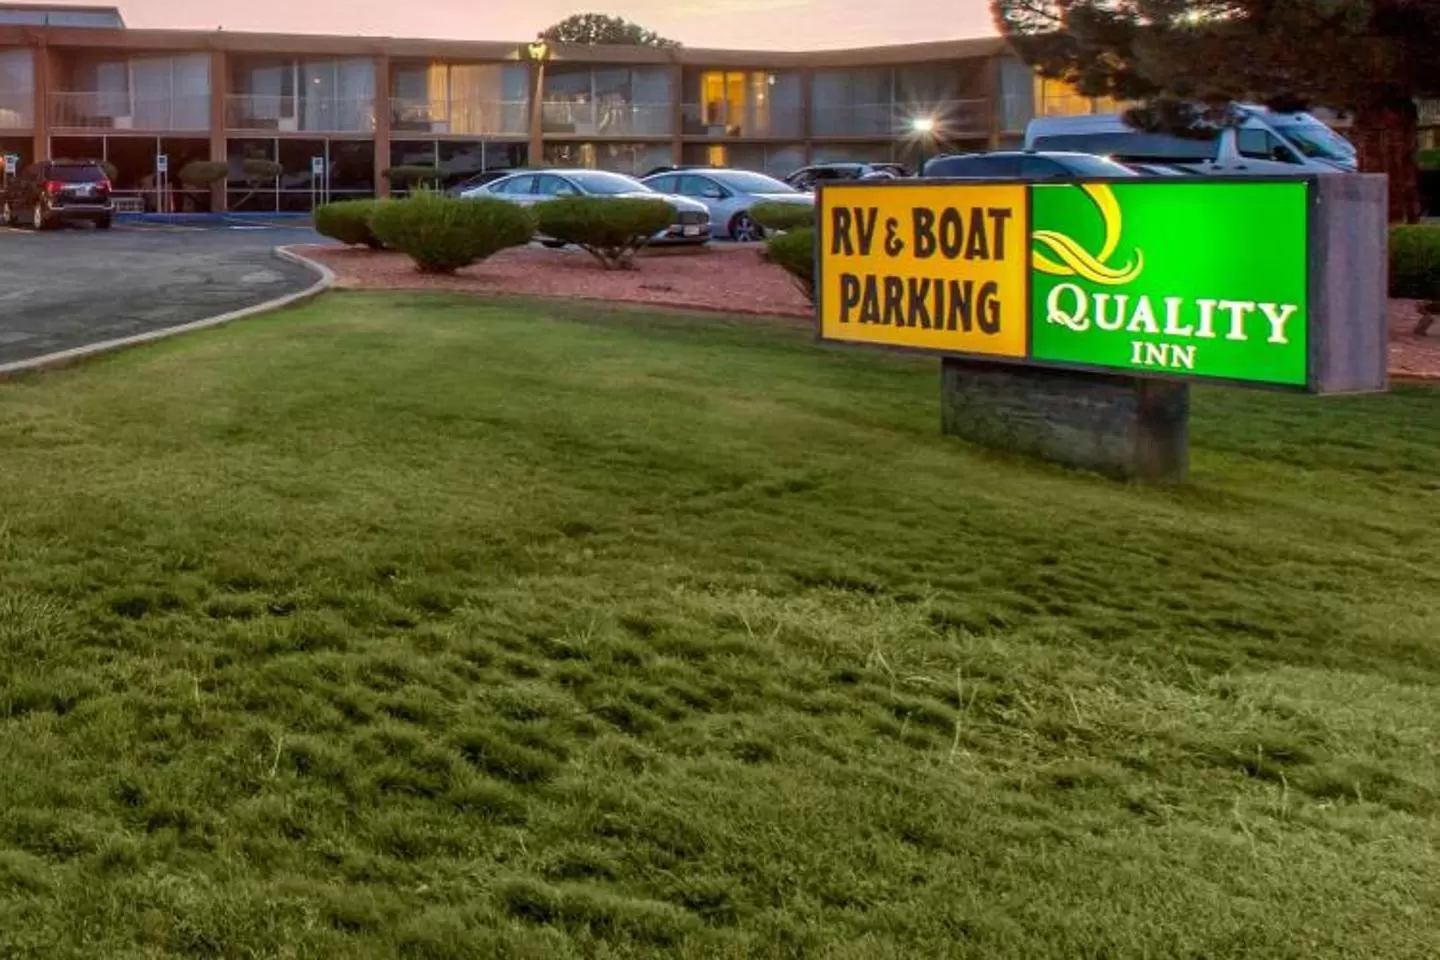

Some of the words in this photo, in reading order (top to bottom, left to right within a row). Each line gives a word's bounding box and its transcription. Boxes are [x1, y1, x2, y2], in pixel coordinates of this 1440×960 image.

[830, 206, 878, 256] RV
[884, 216, 904, 257] &
[912, 206, 1012, 261] BOAT
[839, 271, 1001, 335] PARKING
[1046, 282, 1298, 344] QUALITY
[1130, 340, 1197, 370] INN
